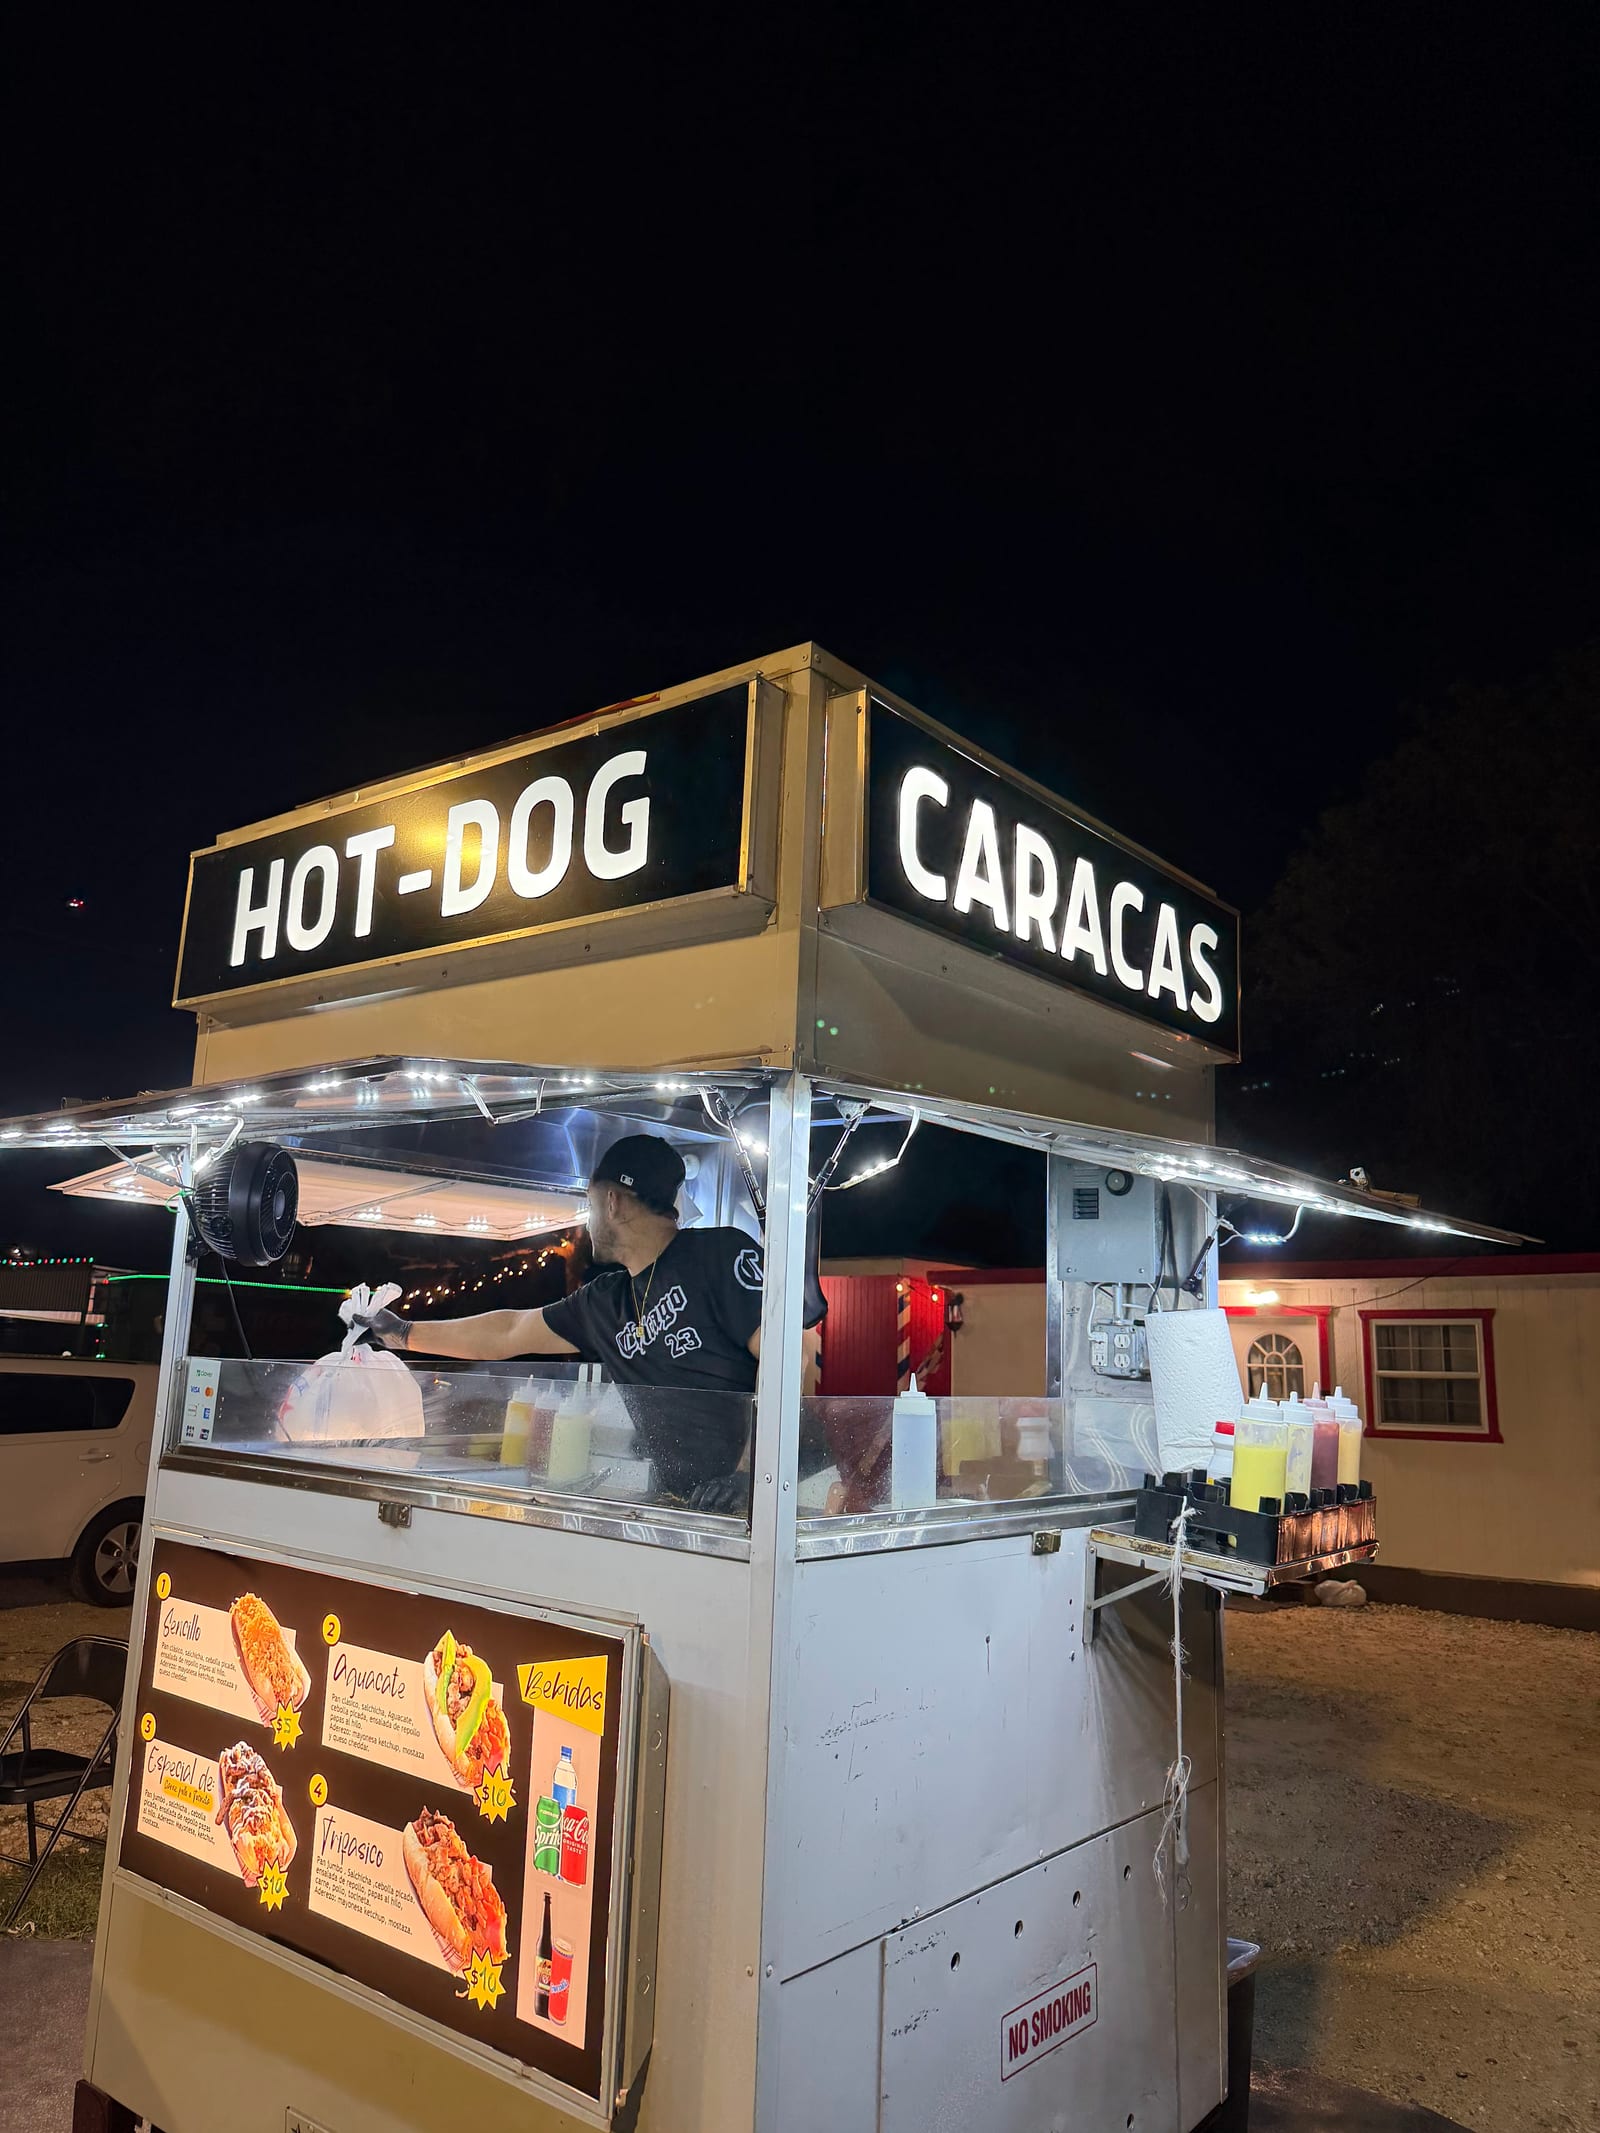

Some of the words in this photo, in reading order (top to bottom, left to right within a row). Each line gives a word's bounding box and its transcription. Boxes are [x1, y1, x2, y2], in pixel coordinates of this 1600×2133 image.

[230, 750, 650, 967] HOT-DOG
[897, 764, 1223, 1023] CARACAS
[664, 1326, 702, 1358] 23
[190, 1385, 200, 1393] VISA
[161, 1578, 166, 1593] 1
[163, 1608, 201, 1641] Sencillo
[327, 1622, 335, 1637] 2
[332, 1693, 340, 1702] Pan
[524, 1665, 603, 1710] Bebidas
[144, 1720, 150, 1733] 3
[276, 1718, 291, 1734] $5
[330, 1714, 344, 1723] papas
[331, 1704, 348, 1715] cebolla
[370, 1716, 392, 1729] ensalada
[393, 1722, 400, 1731] de
[401, 1725, 420, 1738] repollo
[329, 1733, 332, 1741] y
[333, 1734, 347, 1744] queso
[352, 1731, 377, 1744] mayonesa
[402, 1746, 425, 1759] mostaza
[148, 1746, 197, 1784] Especial
[199, 1767, 215, 1792] de:
[314, 1782, 322, 1798] 4
[482, 1784, 506, 1807] $10
[322, 1816, 383, 1868] Trifasico
[566, 1846, 582, 1855] TASTE
[317, 1856, 326, 1867] Pan
[327, 1860, 343, 1873] jumbo
[348, 1868, 372, 1886] Salchicha
[263, 1874, 282, 1894] $10
[315, 1877, 330, 1890] carne,
[316, 1867, 338, 1881] ensalada
[339, 1876, 345, 1884] de
[346, 1880, 366, 1895] repollo,
[368, 1889, 383, 1901] papas
[384, 1896, 390, 1904] al
[338, 1897, 363, 1913] mayonesa
[471, 1966, 496, 1993] $10
[1008, 2018, 1028, 2062] NO
[1031, 1981, 1091, 2047] SMOKING
